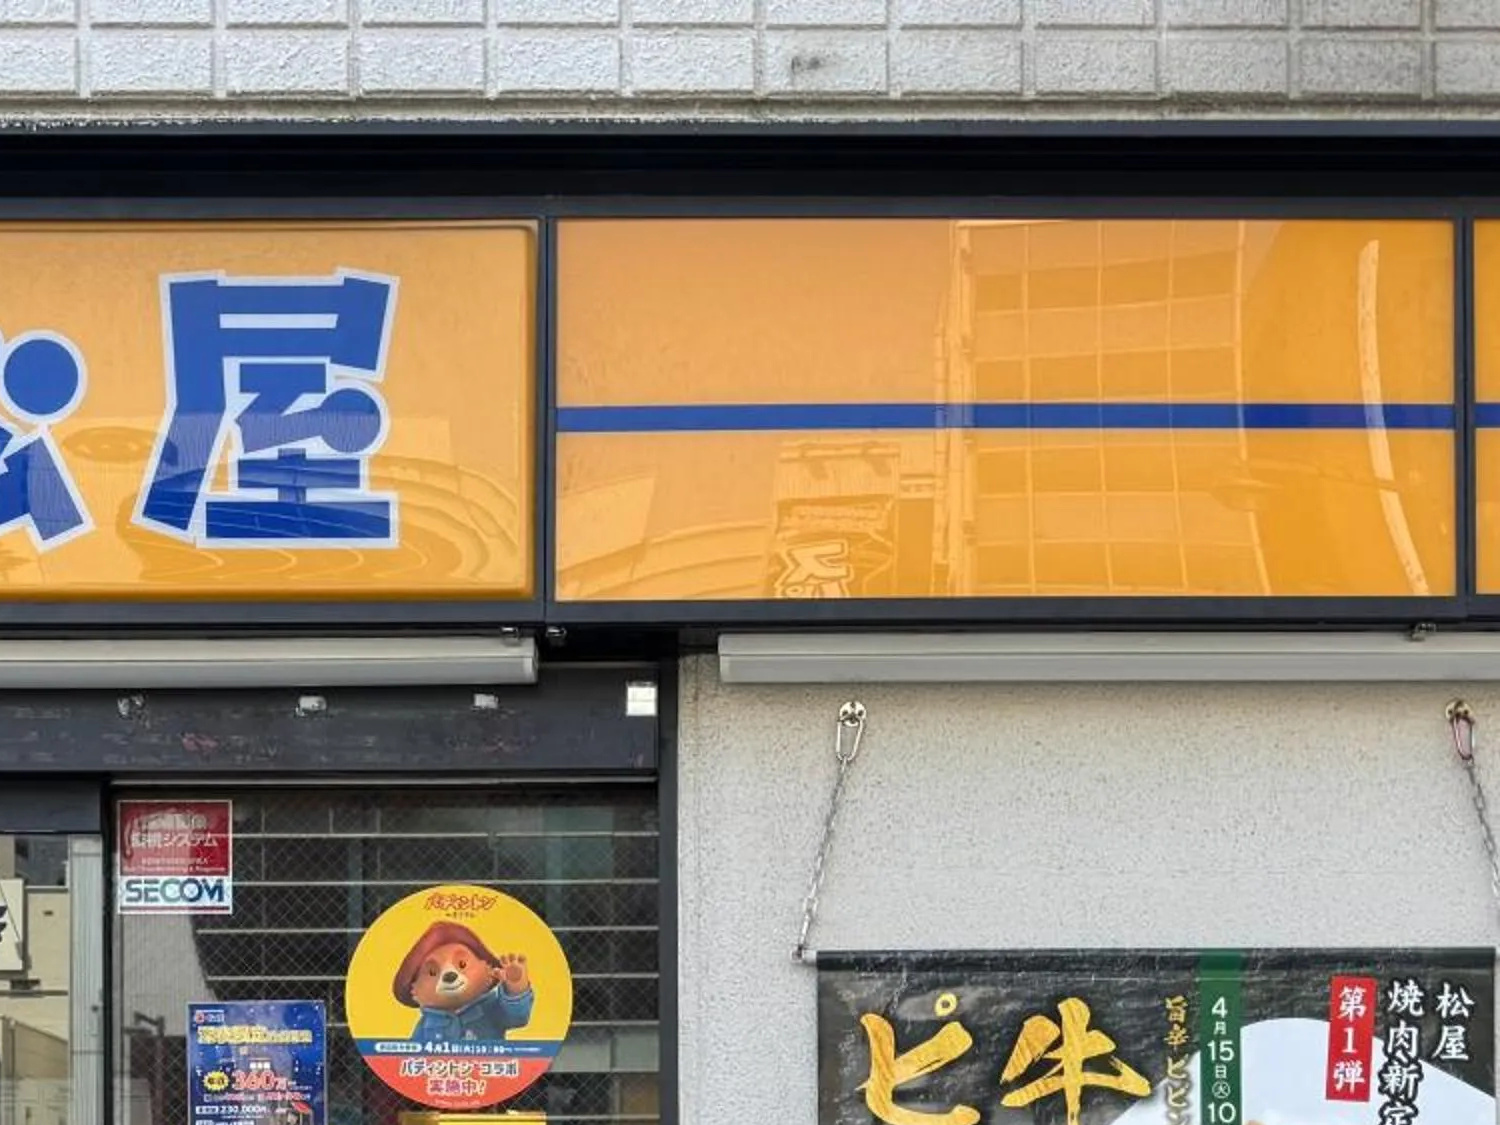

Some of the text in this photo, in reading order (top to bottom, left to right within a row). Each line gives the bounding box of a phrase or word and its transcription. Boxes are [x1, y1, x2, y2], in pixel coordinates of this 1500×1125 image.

[125, 878, 224, 903] SECOM
[1332, 985, 1368, 1094] 第1弾
[1433, 983, 1475, 1061] 松屋
